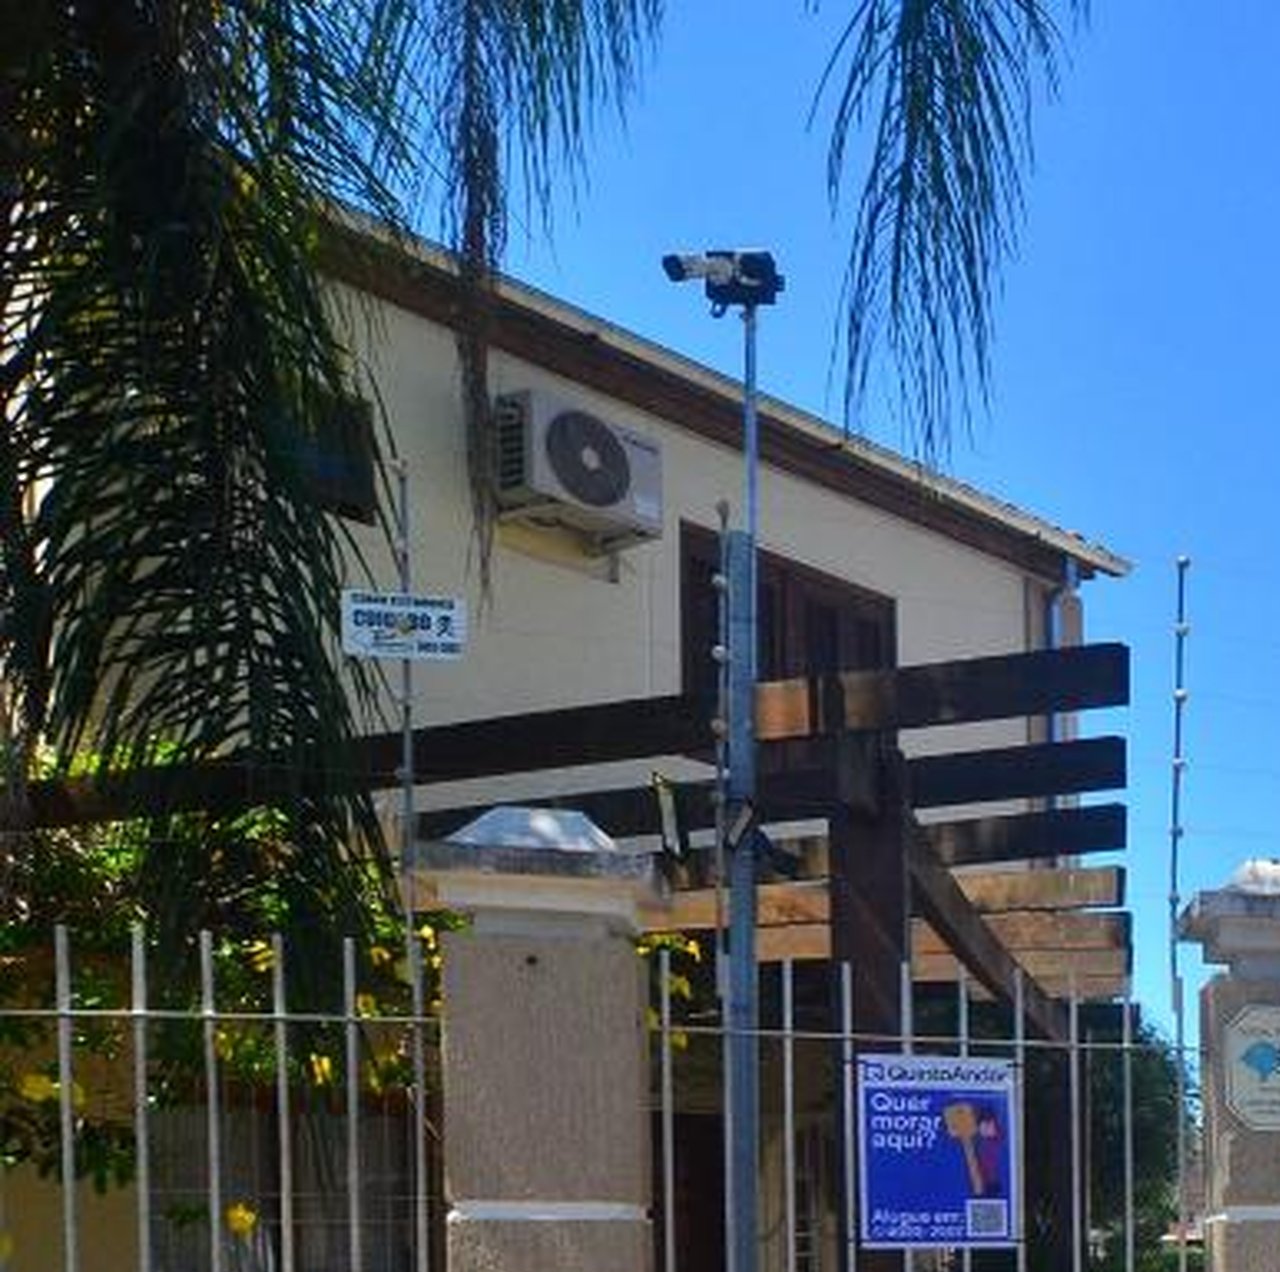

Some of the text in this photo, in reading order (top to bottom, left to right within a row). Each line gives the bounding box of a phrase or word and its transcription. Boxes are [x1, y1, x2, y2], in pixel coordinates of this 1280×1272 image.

[353, 609, 432, 630] CUIDDO
[888, 1065, 1006, 1082] QuintoAndar
[870, 1092, 931, 1112] Quer
[871, 1114, 942, 1130] morar
[871, 1130, 937, 1152] aqui?
